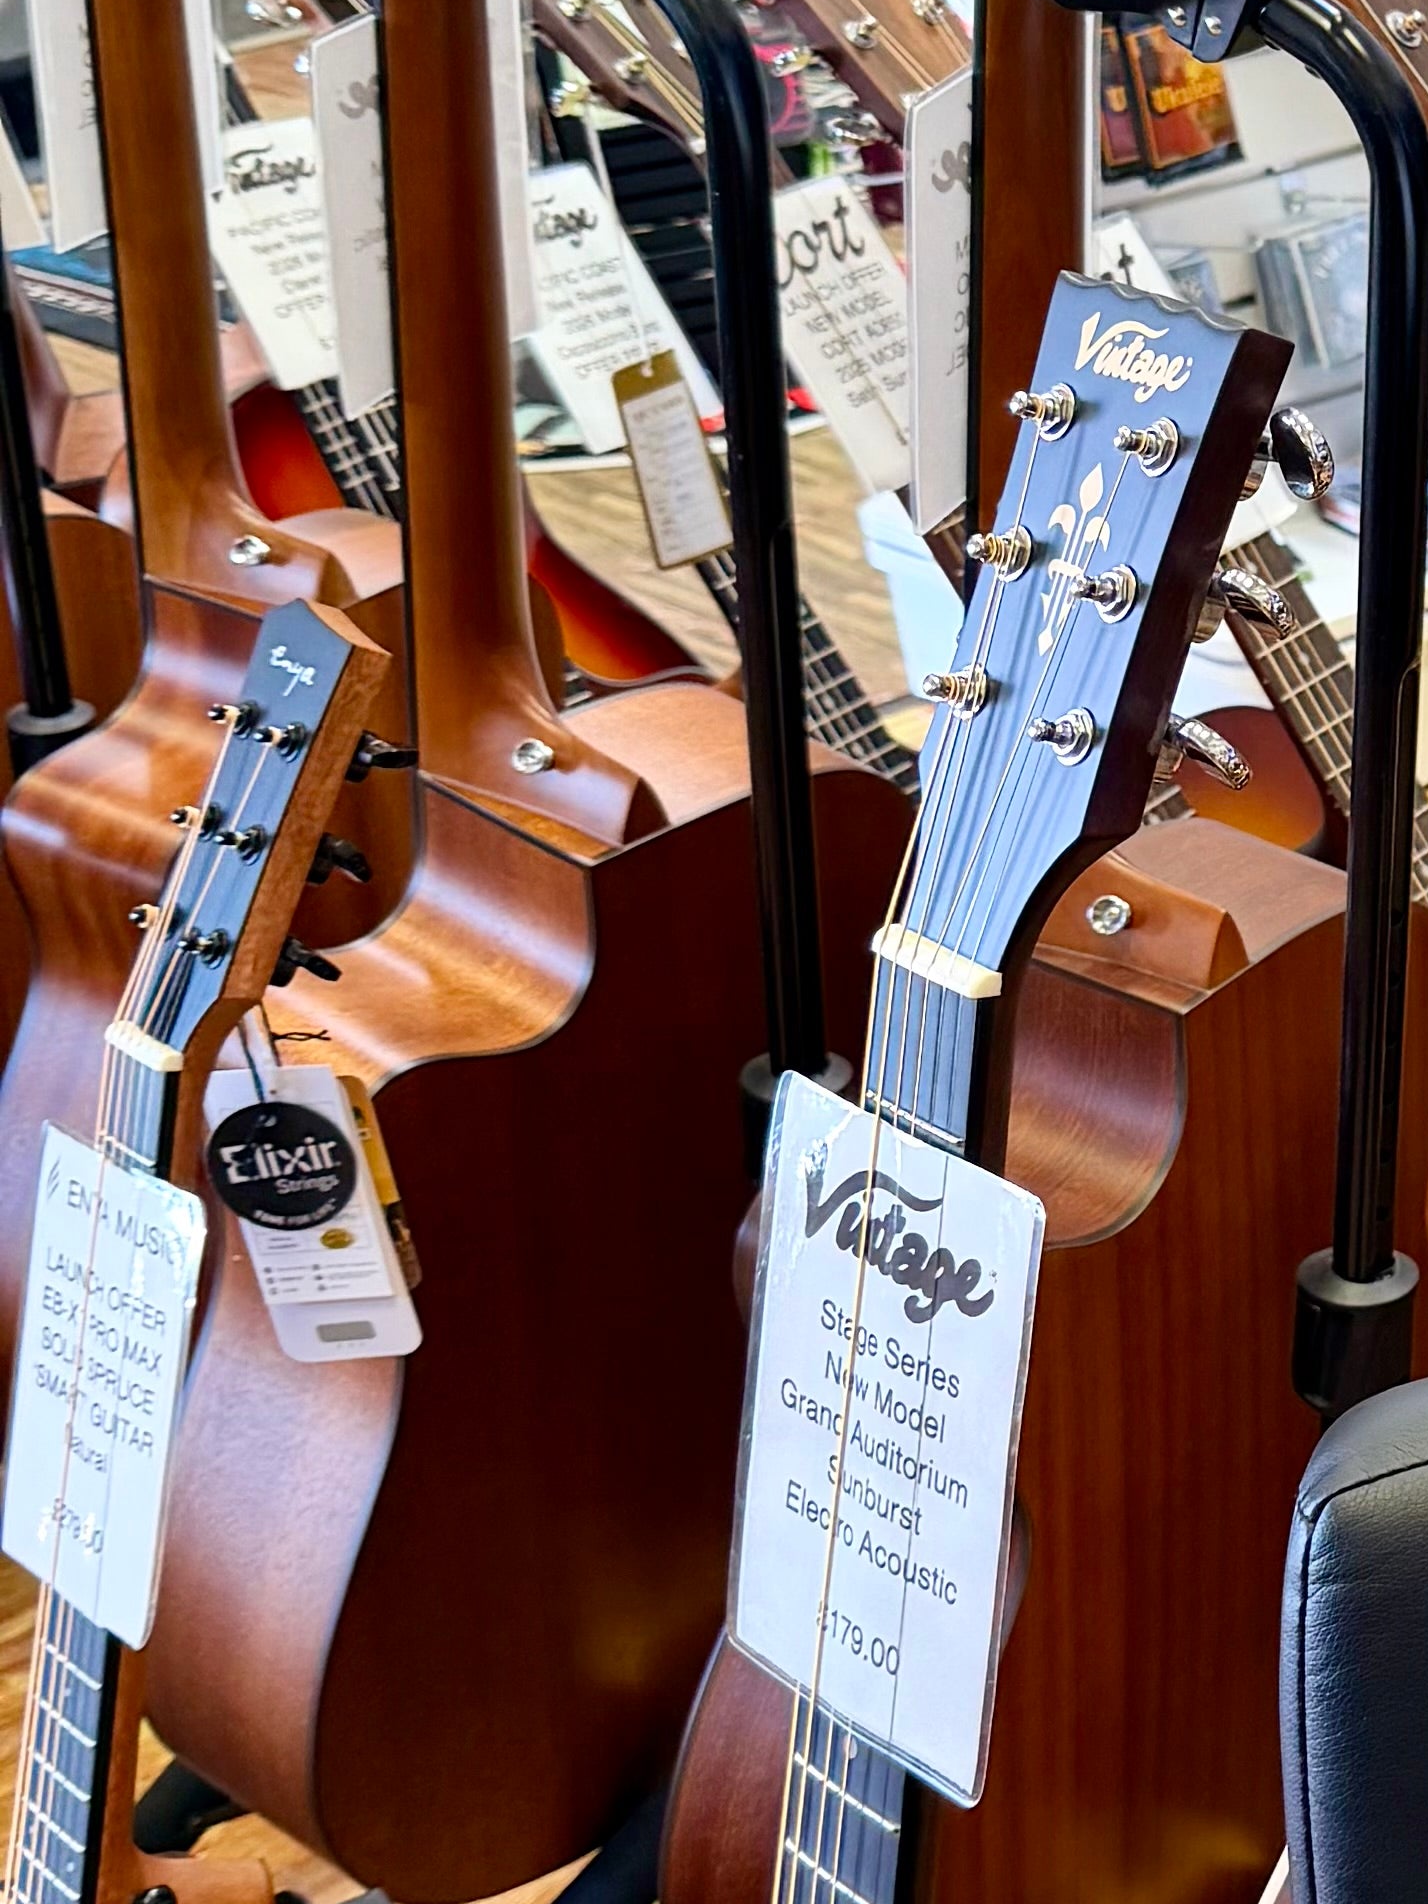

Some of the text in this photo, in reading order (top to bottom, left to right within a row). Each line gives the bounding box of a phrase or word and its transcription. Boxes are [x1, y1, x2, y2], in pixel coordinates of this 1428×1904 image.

[1074, 311, 1193, 403] Vintage
[218, 1137, 341, 1185] Elixir
[67, 1179, 109, 1233] ENA
[804, 1158, 995, 1325] Vintage
[107, 1284, 167, 1337] OFFER
[821, 1298, 961, 1399] Stage Series
[122, 1335, 164, 1377] MAX
[89, 1403, 155, 1457] GUITAR
[825, 1350, 948, 1446] New Model
[828, 1454, 924, 1537] Sunburst
[851, 1427, 969, 1509] Auditorium
[785, 1479, 959, 1607] Elecro Acoustic
